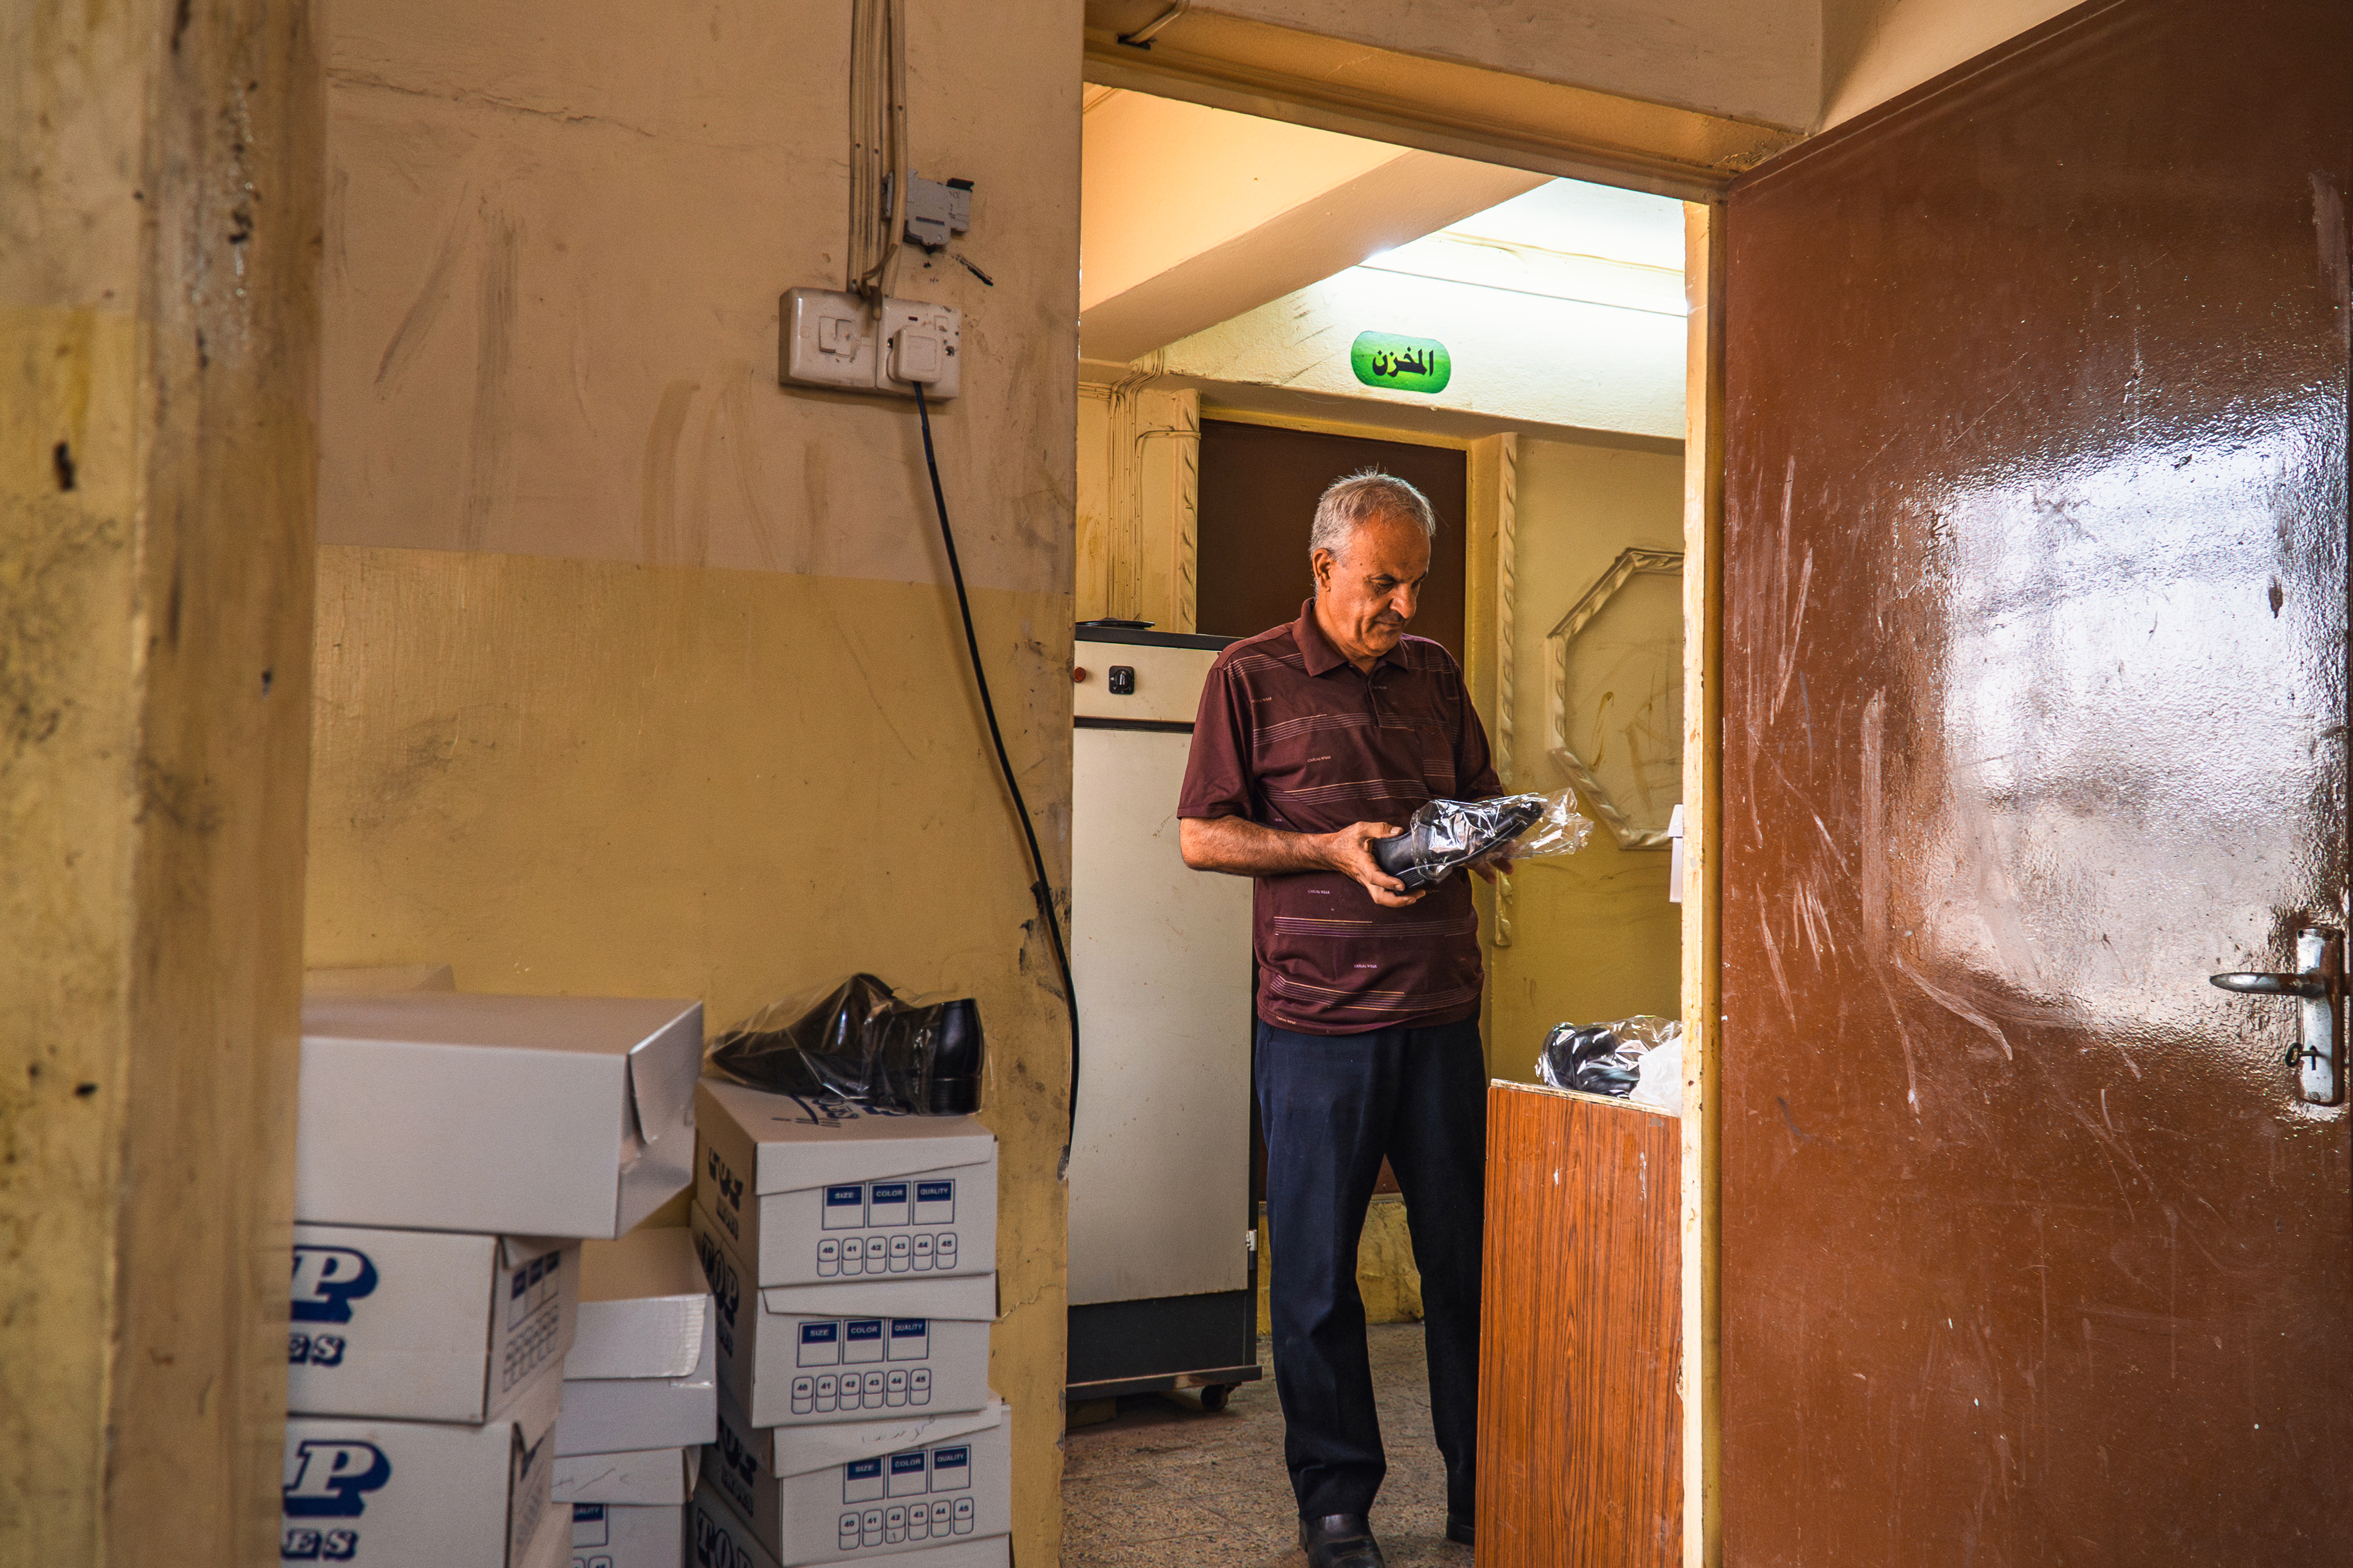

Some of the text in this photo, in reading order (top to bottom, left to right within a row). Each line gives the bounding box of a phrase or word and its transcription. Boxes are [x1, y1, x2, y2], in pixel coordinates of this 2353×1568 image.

[1372, 346, 1433, 377] المخزن
[894, 1458, 921, 1468] COLOR
[937, 1454, 964, 1463] QUALITY
